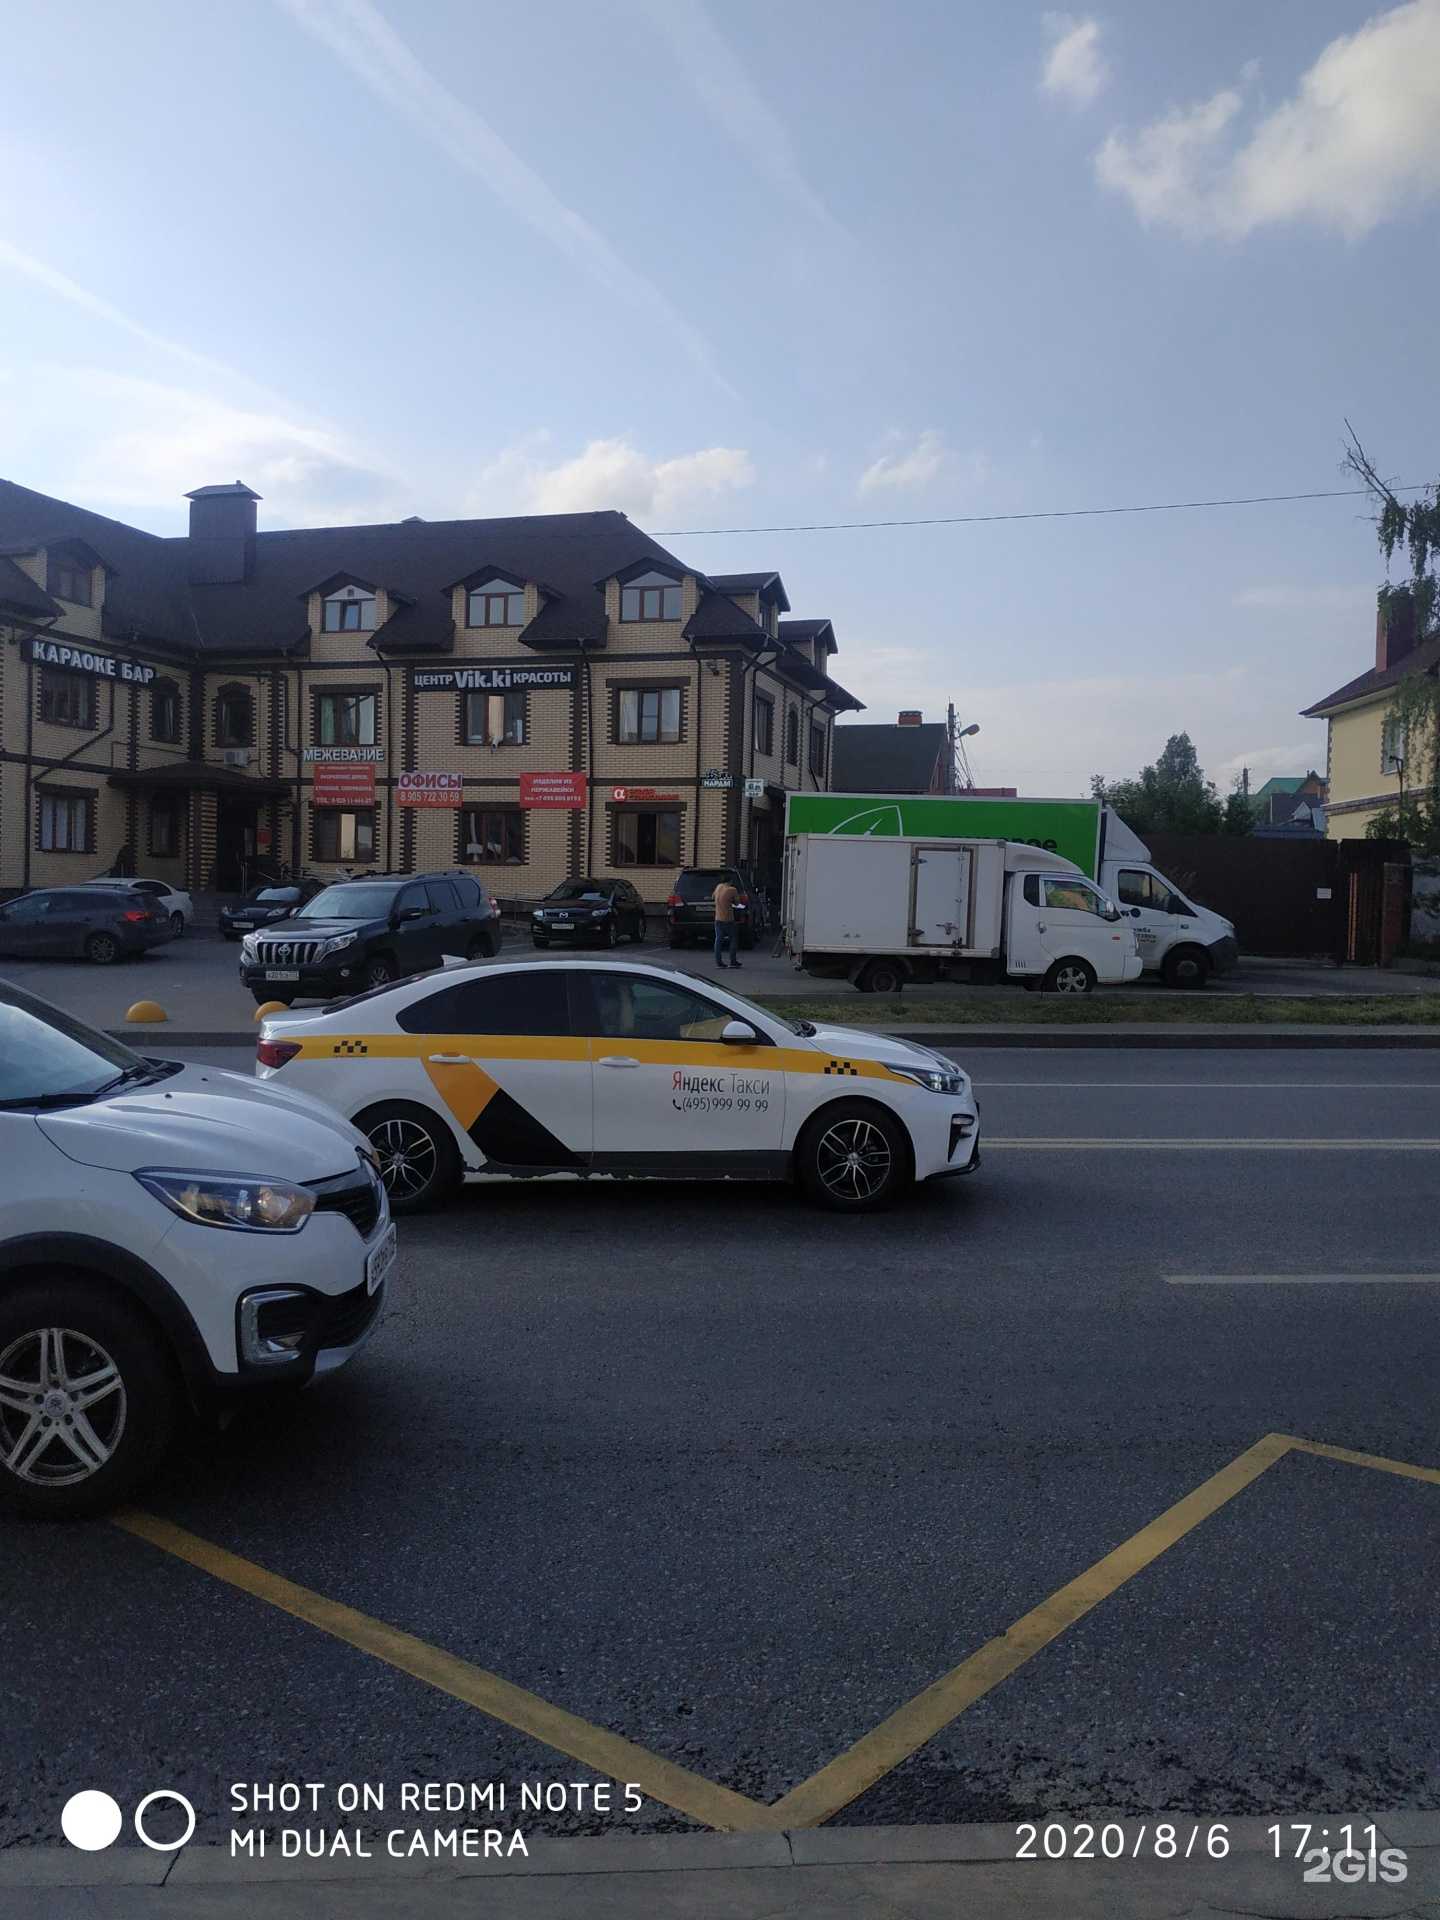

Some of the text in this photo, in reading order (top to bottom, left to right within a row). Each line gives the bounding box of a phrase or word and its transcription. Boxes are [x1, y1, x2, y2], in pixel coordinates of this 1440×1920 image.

[32, 641, 154, 683] КАРАОКЕ БАР
[414, 670, 571, 688] ЦЕНТР Vik.ki КРАСОТЫ
[303, 749, 385, 761] МЕЖЕВАНИЕ
[400, 774, 463, 788] ОФИСЫ
[400, 791, 406, 801] 8
[672, 1071, 770, 1095] Яндекс Такси
